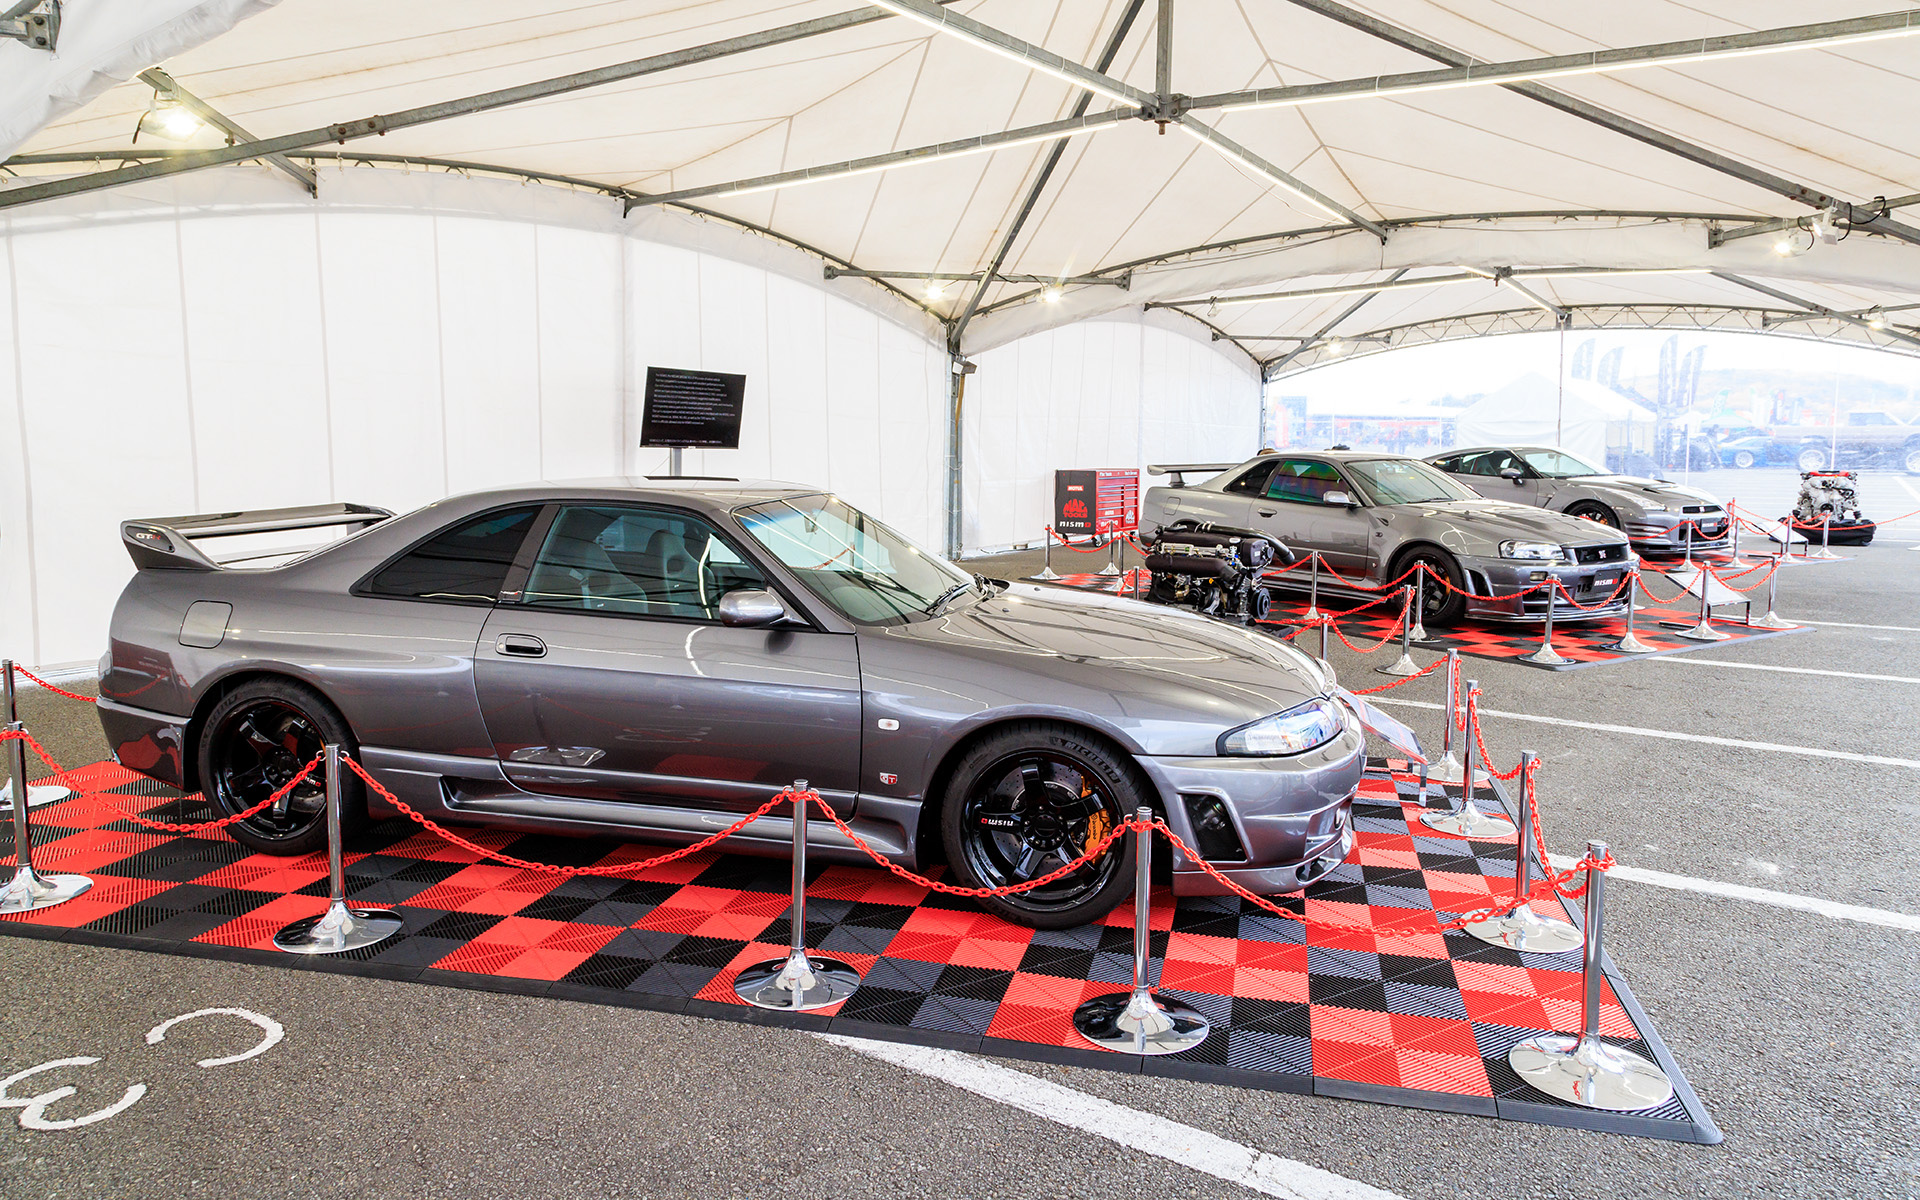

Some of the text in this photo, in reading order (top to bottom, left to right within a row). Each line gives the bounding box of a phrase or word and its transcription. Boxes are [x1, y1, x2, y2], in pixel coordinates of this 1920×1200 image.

[1594, 578, 1618, 586] nismo
[1065, 741, 1121, 783] MICHELIN
[880, 774, 896, 784] GT
[981, 817, 1014, 827] nismo
